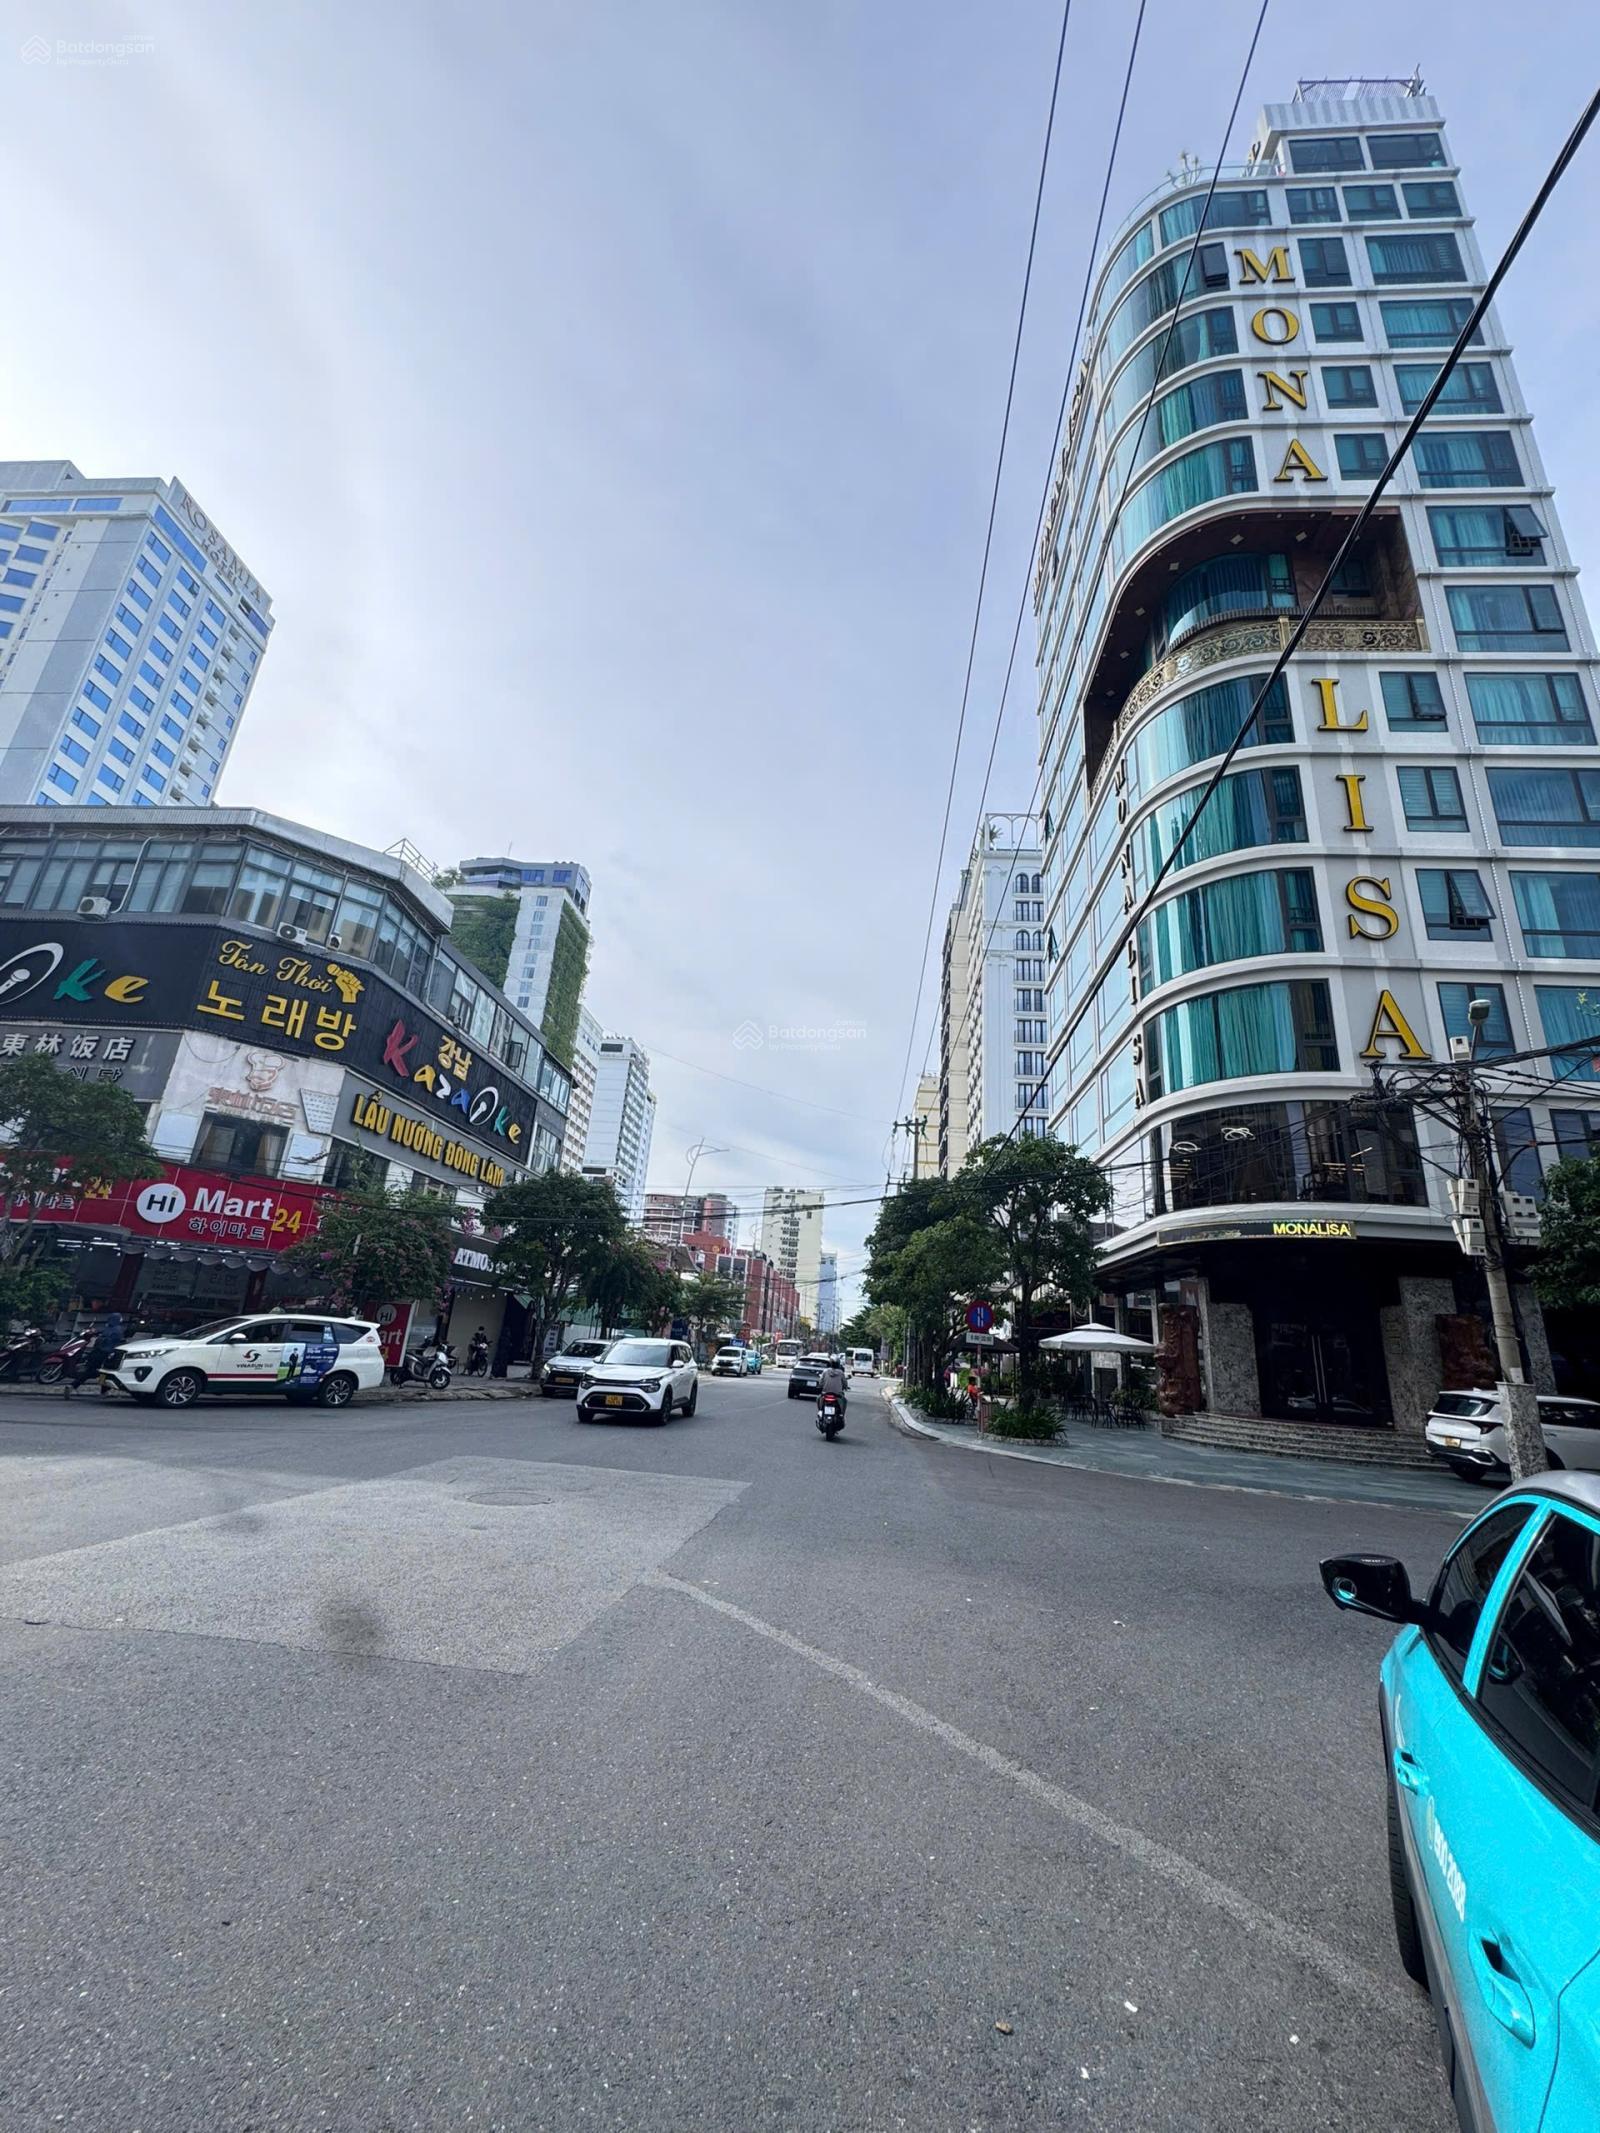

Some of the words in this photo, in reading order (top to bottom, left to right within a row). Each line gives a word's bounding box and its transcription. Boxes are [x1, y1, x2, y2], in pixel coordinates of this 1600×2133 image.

[1234, 246, 1328, 482] MONA
[1311, 678, 1432, 1059] LISA
[218, 940, 269, 975] Tân
[276, 957, 332, 993] Thời
[196, 980, 357, 1050] 노래방
[438, 1035, 473, 1081] 강남
[352, 1090, 391, 1135] LẨU
[390, 1113, 444, 1161] NƯỚNG
[188, 1216, 266, 1241] 하이마트
[192, 1187, 273, 1220] Mart
[271, 1208, 302, 1234] 24
[1273, 1222, 1350, 1236] MONALISA
